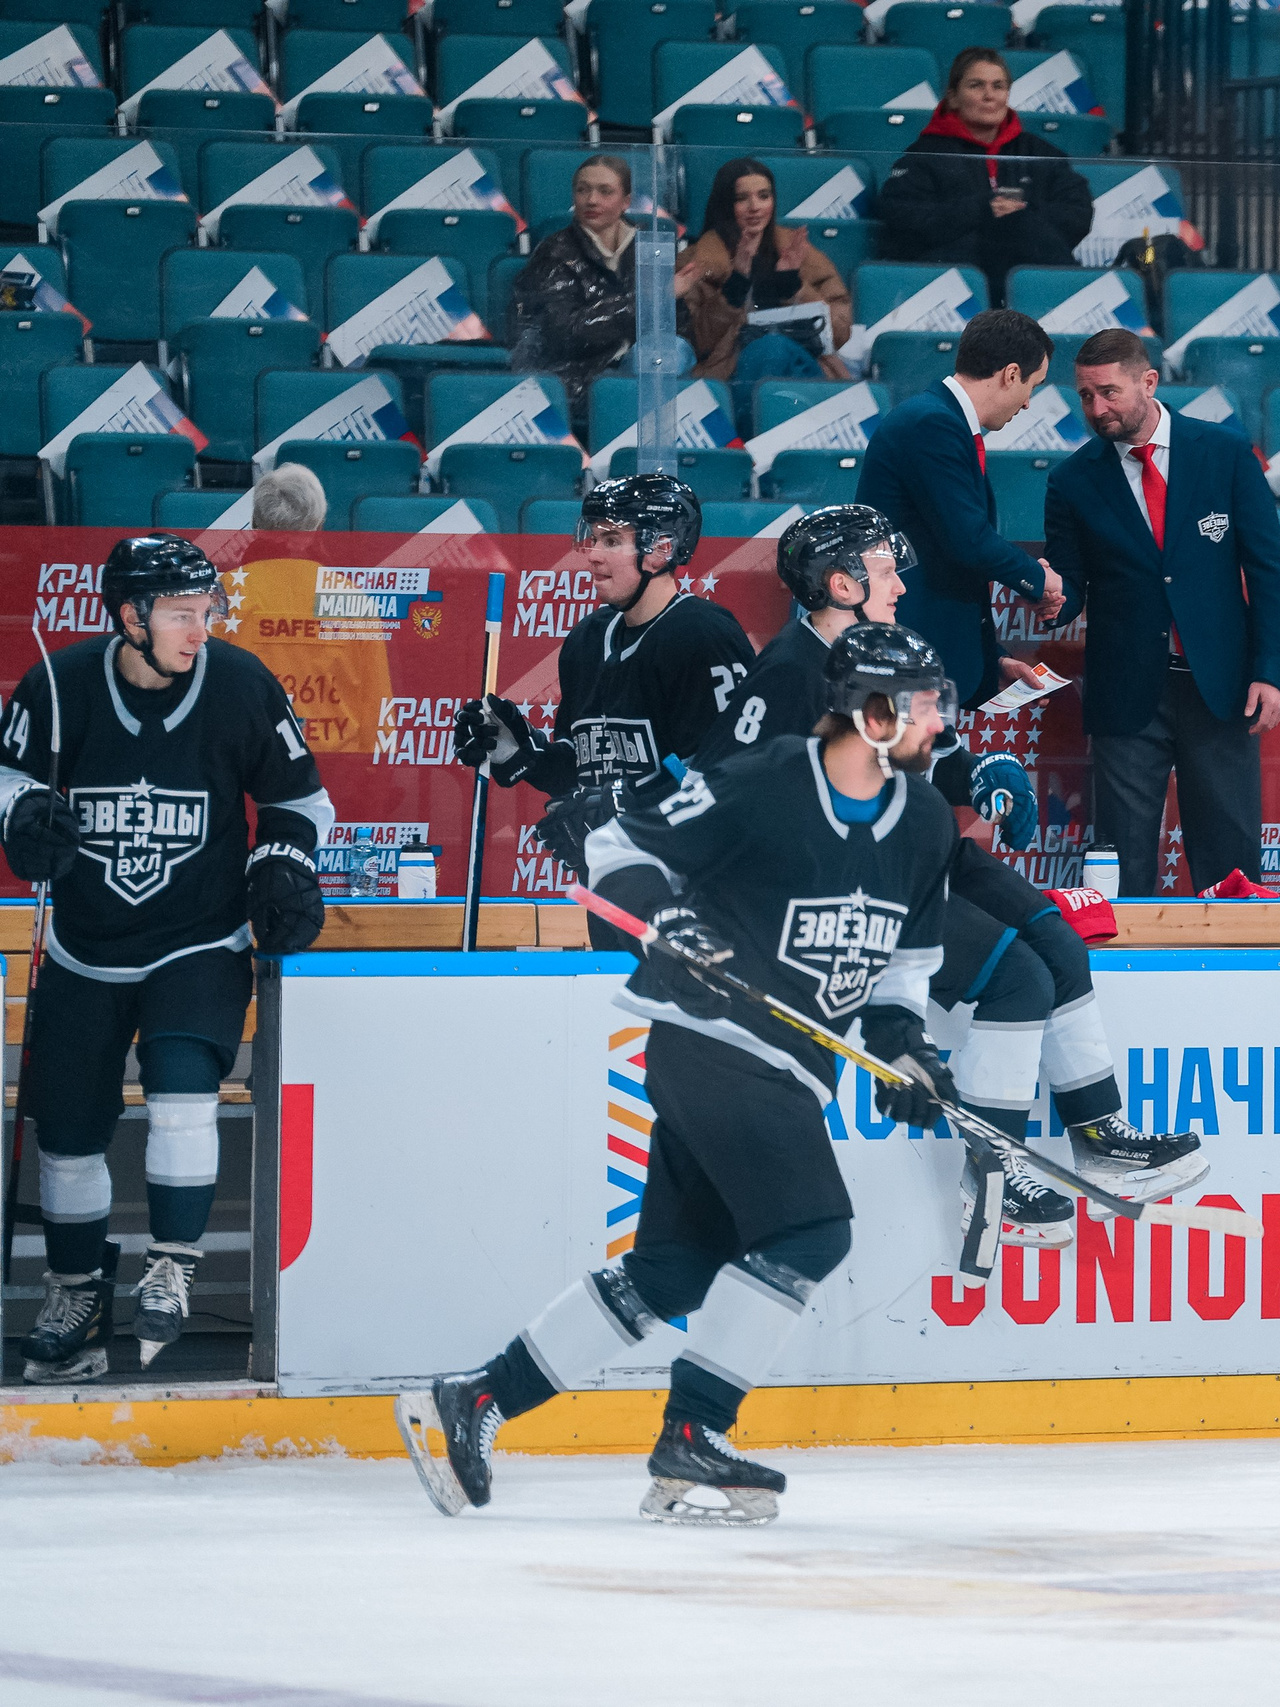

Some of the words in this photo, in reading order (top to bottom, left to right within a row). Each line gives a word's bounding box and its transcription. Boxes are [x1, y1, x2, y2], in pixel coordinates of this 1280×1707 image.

[190, 568, 213, 579] CCM
[321, 571, 398, 590] КРАСНАЯ
[317, 595, 398, 618] МАШИНА
[512, 602, 608, 638] МАШ
[734, 695, 767, 744] 8
[275, 704, 308, 761] 1
[79, 795, 201, 837] ЗВЁЗДЫ
[133, 834, 148, 848] И
[327, 826, 397, 845] РААЯ
[991, 824, 1096, 854] КАСНА
[116, 853, 162, 878] ВХЛ
[317, 850, 397, 872] МАНА
[1001, 856, 1084, 890] АШИ
[828, 965, 870, 993] ВХЛ
[1110, 1148, 1151, 1161] BAUER
